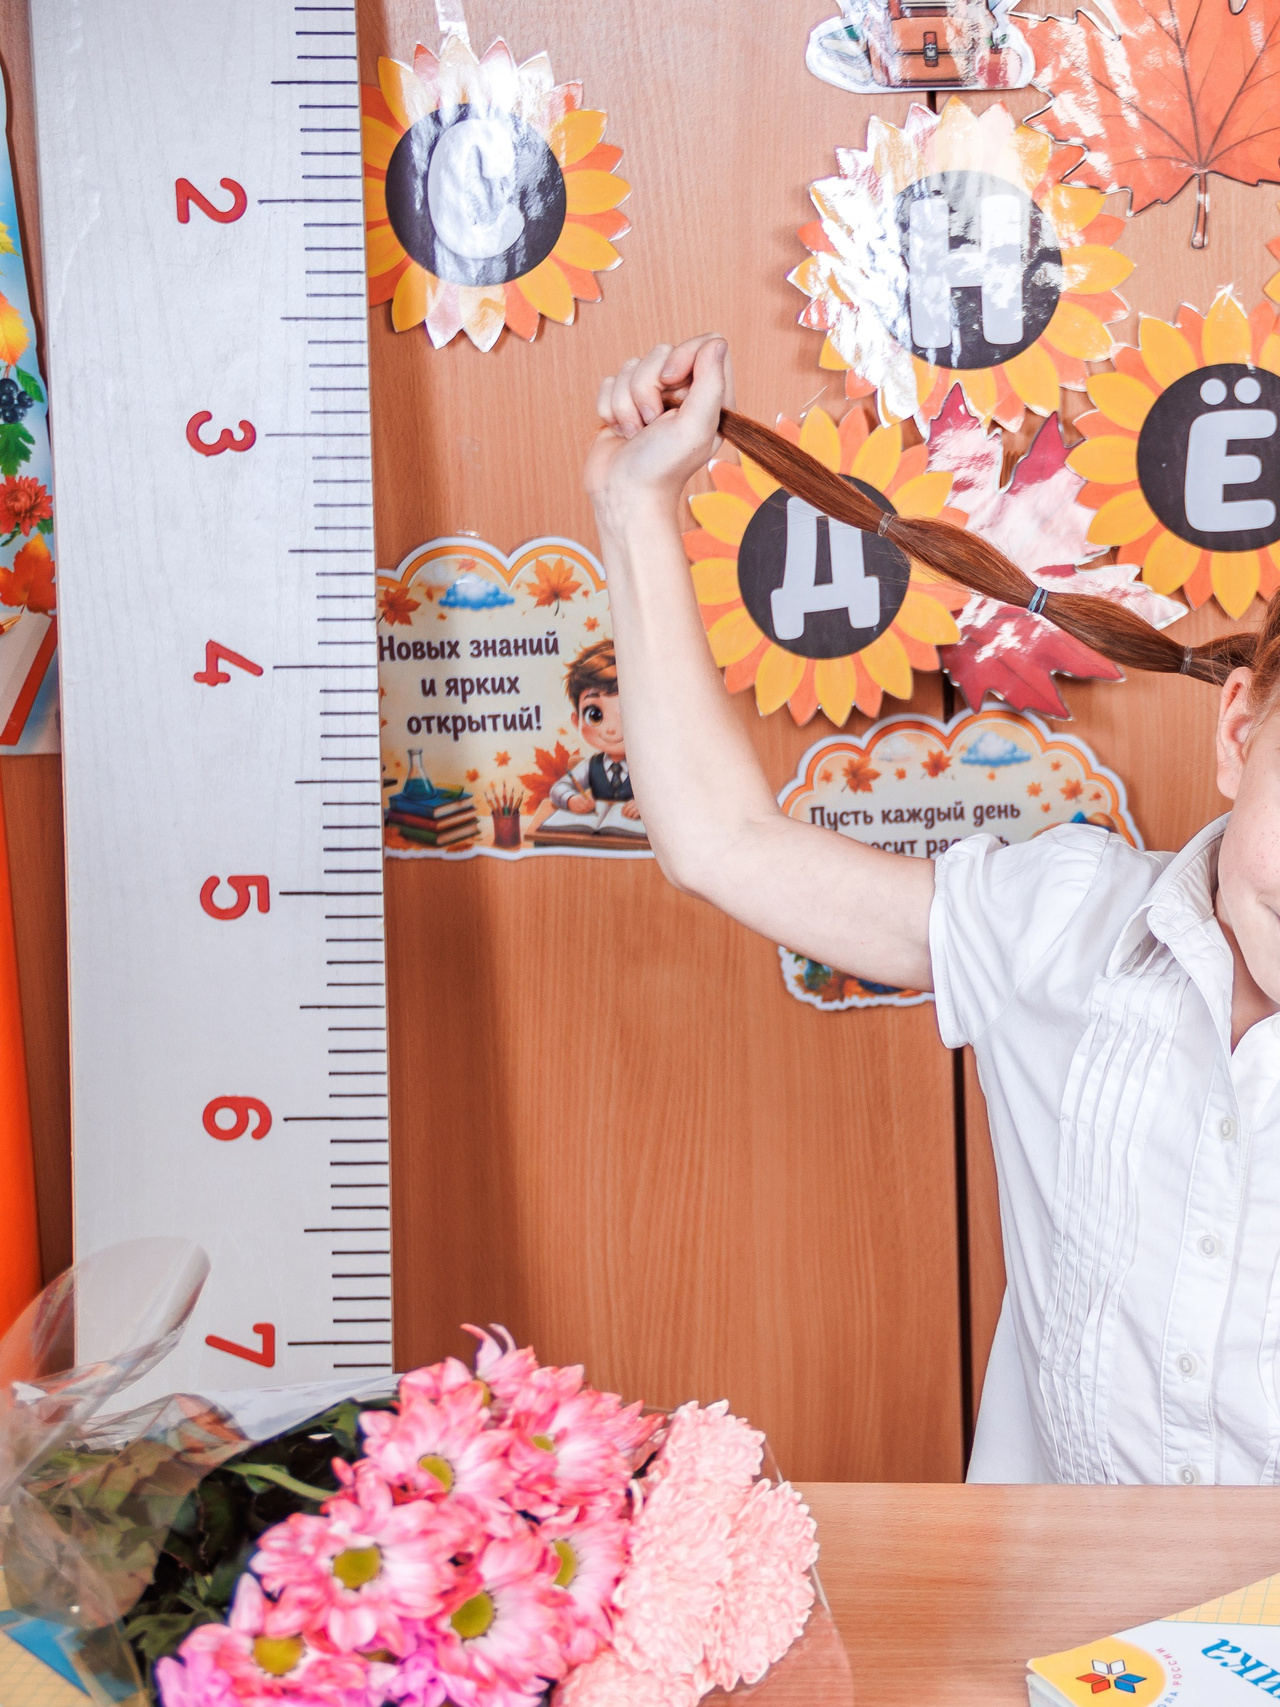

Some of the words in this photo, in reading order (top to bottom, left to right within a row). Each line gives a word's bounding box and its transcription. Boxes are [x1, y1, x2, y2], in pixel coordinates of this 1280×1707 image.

[175, 177, 248, 225] 2
[186, 410, 257, 456] 3
[193, 639, 264, 687] 4
[377, 635, 461, 661] Новых
[470, 631, 560, 659] знаний
[420, 677, 438, 697] и
[445, 675, 521, 704] ярких
[406, 704, 543, 741] открытий!
[810, 806, 874, 830] Пусть
[881, 801, 965, 829] каждый
[972, 803, 1021, 828] день
[199, 875, 271, 921] 5
[205, 1322, 275, 1368] 7
[1155, 1647, 1183, 1686] РОССИИ
